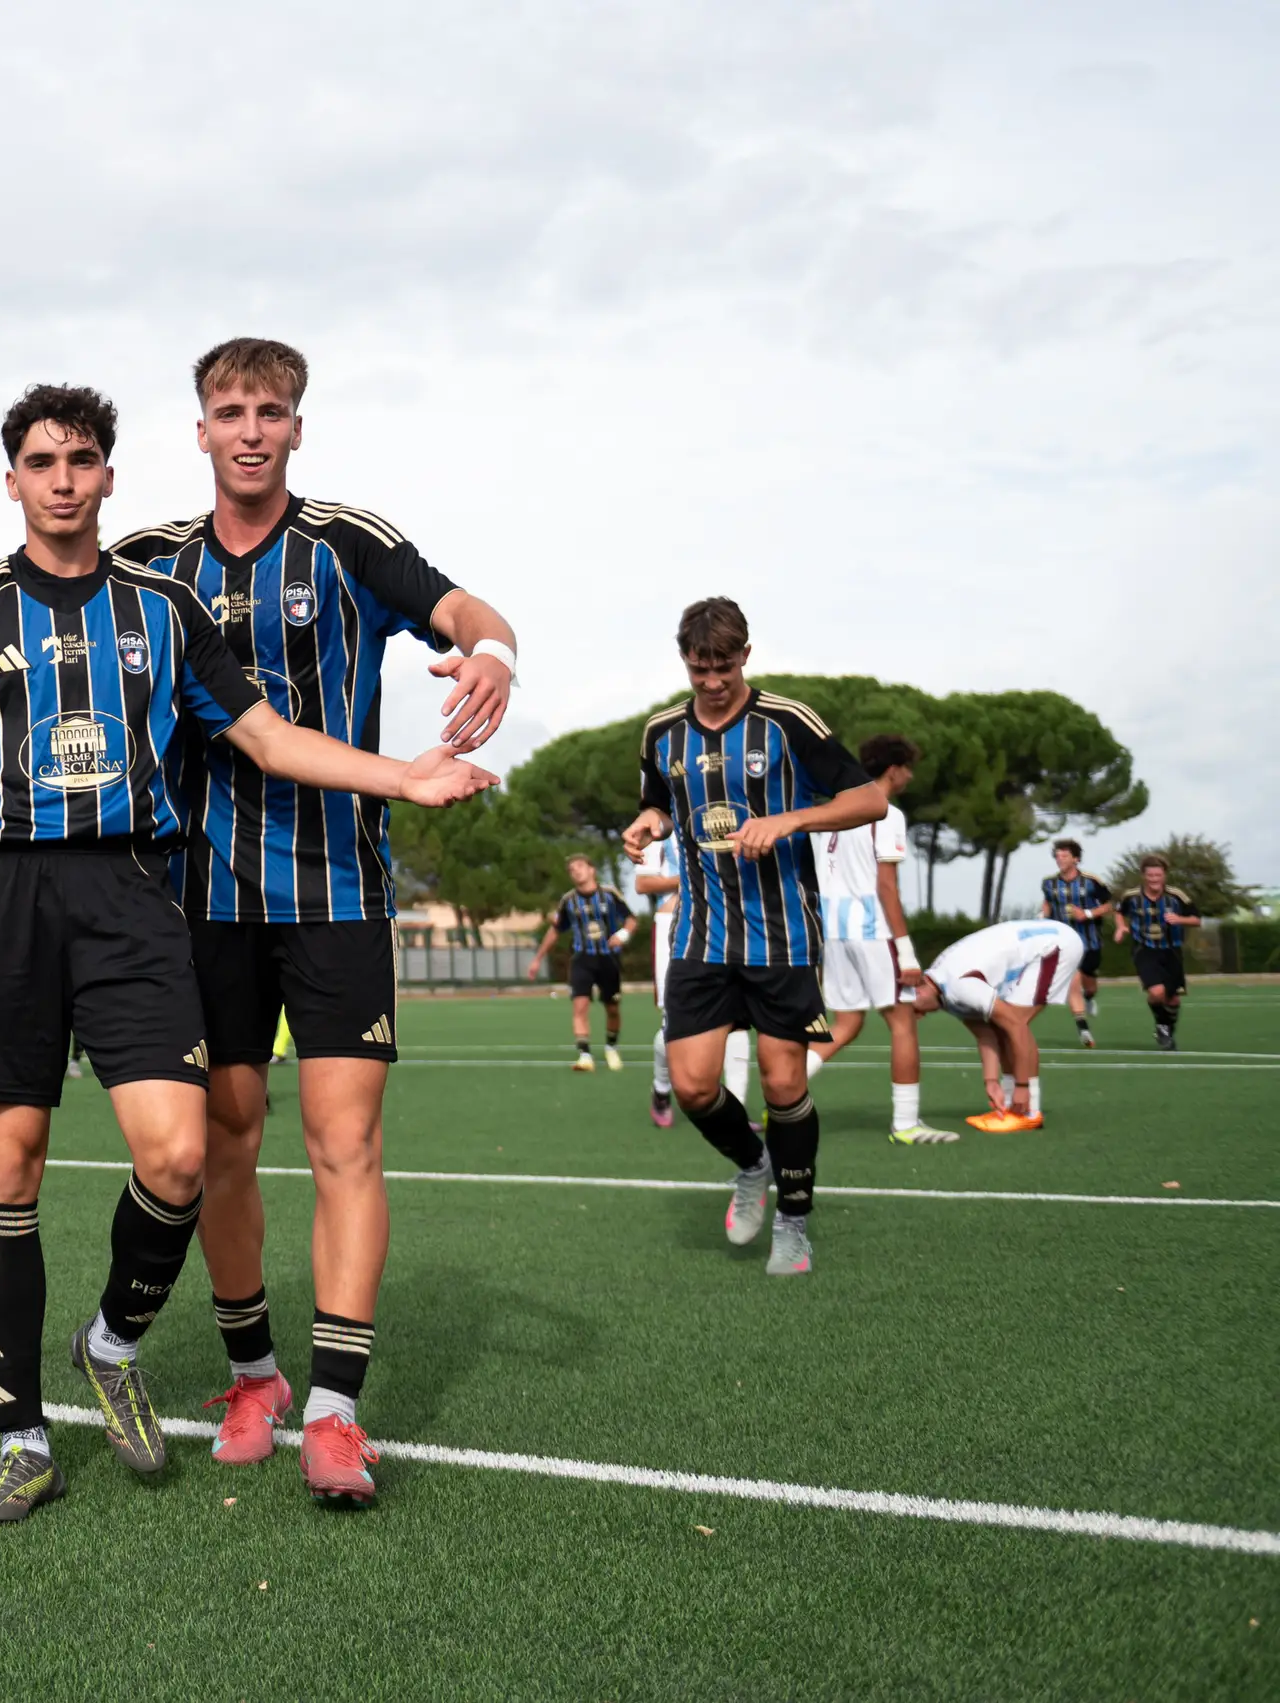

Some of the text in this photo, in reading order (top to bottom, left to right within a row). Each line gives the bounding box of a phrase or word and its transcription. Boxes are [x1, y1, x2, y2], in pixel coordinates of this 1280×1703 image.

[285, 587, 311, 599] PISA
[120, 636, 145, 647] PISA
[51, 751, 106, 763] TERME DI
[780, 1167, 812, 1179] PISA
